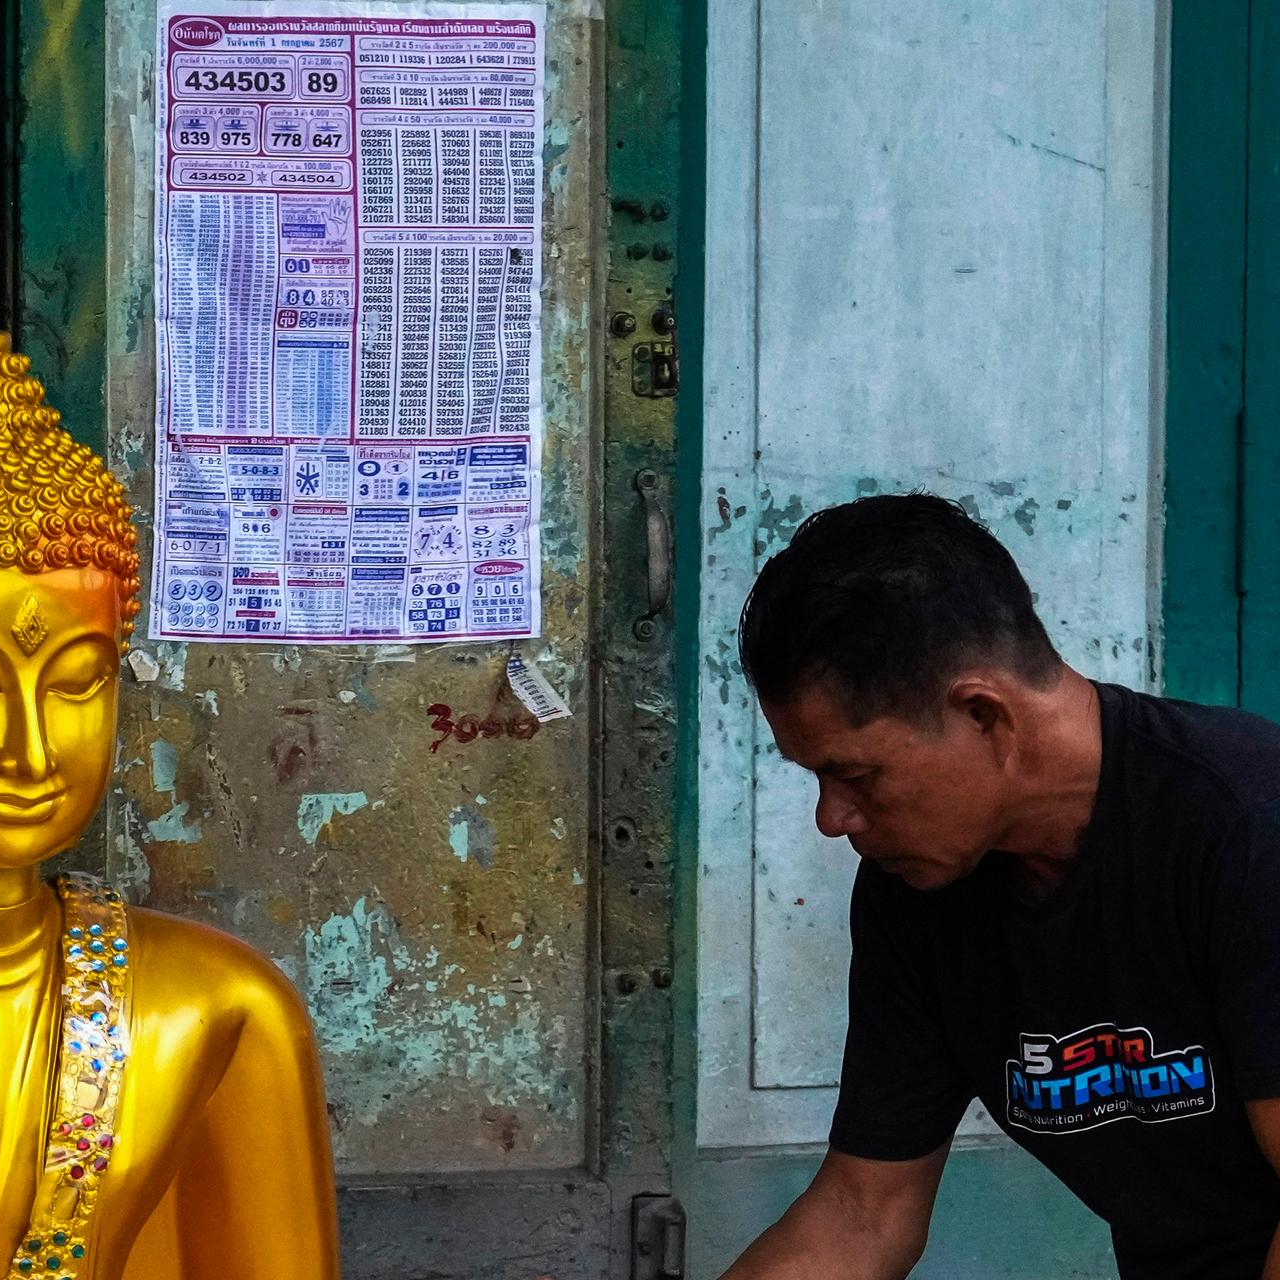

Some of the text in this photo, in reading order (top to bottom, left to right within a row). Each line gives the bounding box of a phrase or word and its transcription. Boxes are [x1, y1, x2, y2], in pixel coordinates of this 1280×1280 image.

[319, 38, 344, 48] 2567
[359, 55, 390, 63] 051210
[435, 56, 466, 64] 120284
[185, 70, 286, 92] 434503
[307, 72, 338, 93] 89
[360, 87, 391, 95] 067625
[438, 97, 469, 105] 444531
[180, 131, 251, 146] 839 975
[271, 133, 342, 148] 778 647
[189, 172, 246, 181] 434502
[279, 174, 335, 183] 434504
[241, 466, 279, 475] 5-0-8-3
[392, 464, 399, 472] 1
[421, 470, 459, 481] 4 6
[359, 484, 369, 496] 3
[398, 481, 409, 496] 2
[242, 523, 271, 533] 8 6
[474, 524, 514, 535] 8 3
[421, 532, 454, 550] 7 4
[472, 538, 516, 549] 82 89
[170, 540, 220, 553] 6-0 7-1
[473, 550, 490, 559] 31
[171, 583, 217, 597] 8 3 9
[477, 585, 519, 596] 9 0 6
[412, 599, 459, 609] 52 10
[430, 610, 442, 619] 73
[250, 622, 255, 630] 7
[413, 623, 425, 631] 59
[1023, 1033, 1147, 1075] 5 STR
[1093, 1098, 1134, 1117] Weigh
[1151, 1095, 1205, 1113] Vitamins
